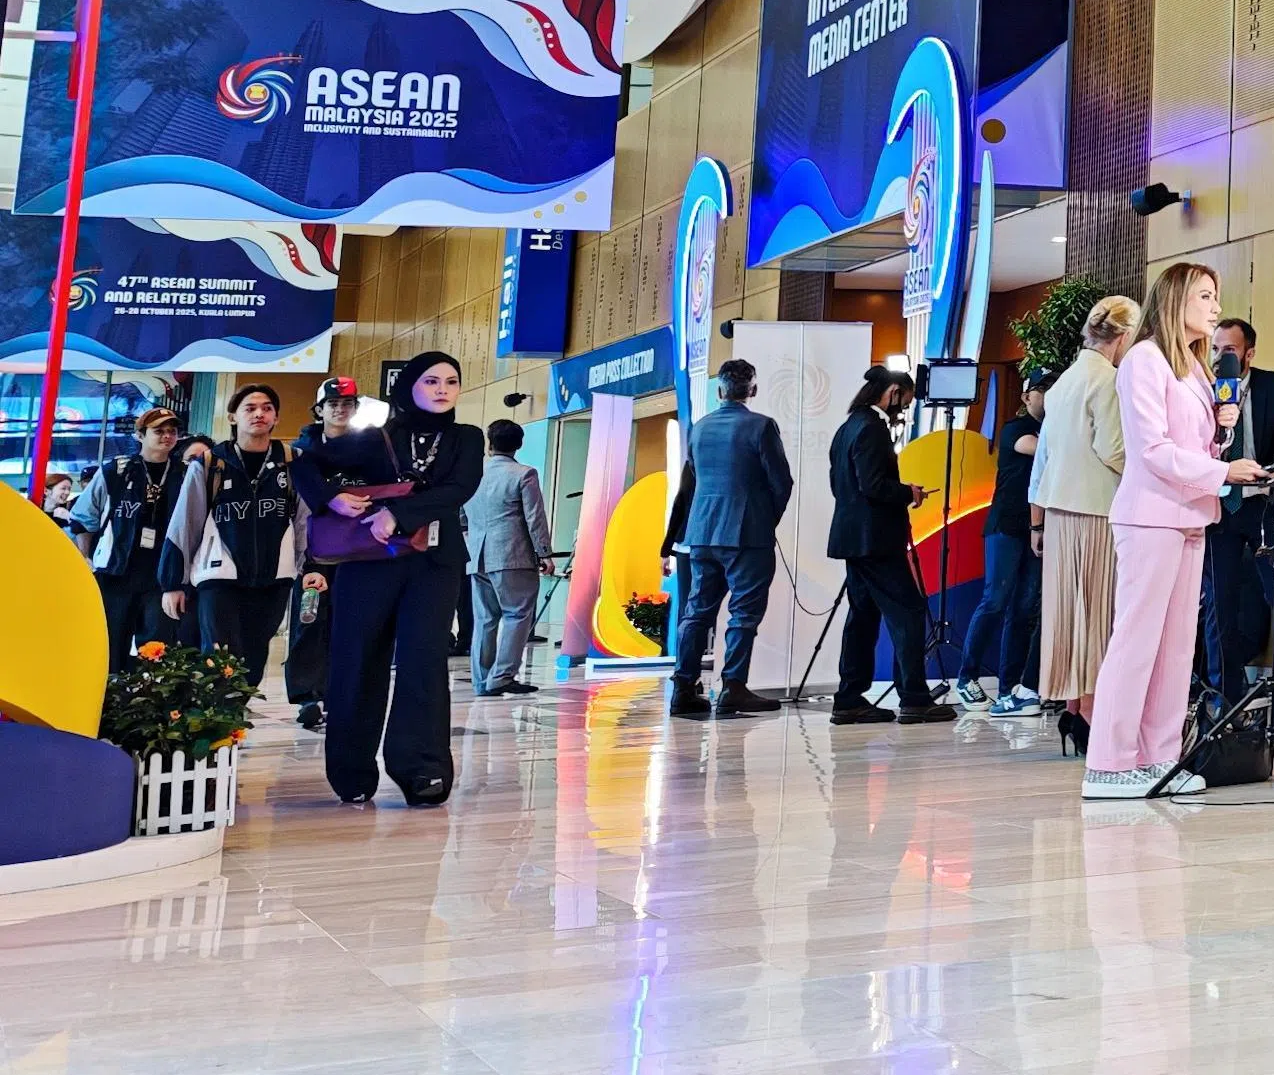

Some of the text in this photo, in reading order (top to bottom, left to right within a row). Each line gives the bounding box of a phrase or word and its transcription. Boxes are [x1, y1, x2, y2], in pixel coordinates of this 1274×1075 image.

[807, 14, 851, 78] MEDIA
[306, 66, 461, 111] ASEAN
[304, 105, 458, 128] MALAYSIA 2025
[303, 123, 457, 139] INCLUSIVITY AND SUSTAINABILITY
[117, 276, 257, 290] 47TH ASEAN SUMMIT
[104, 291, 266, 306] AND RELATED SUMMITS
